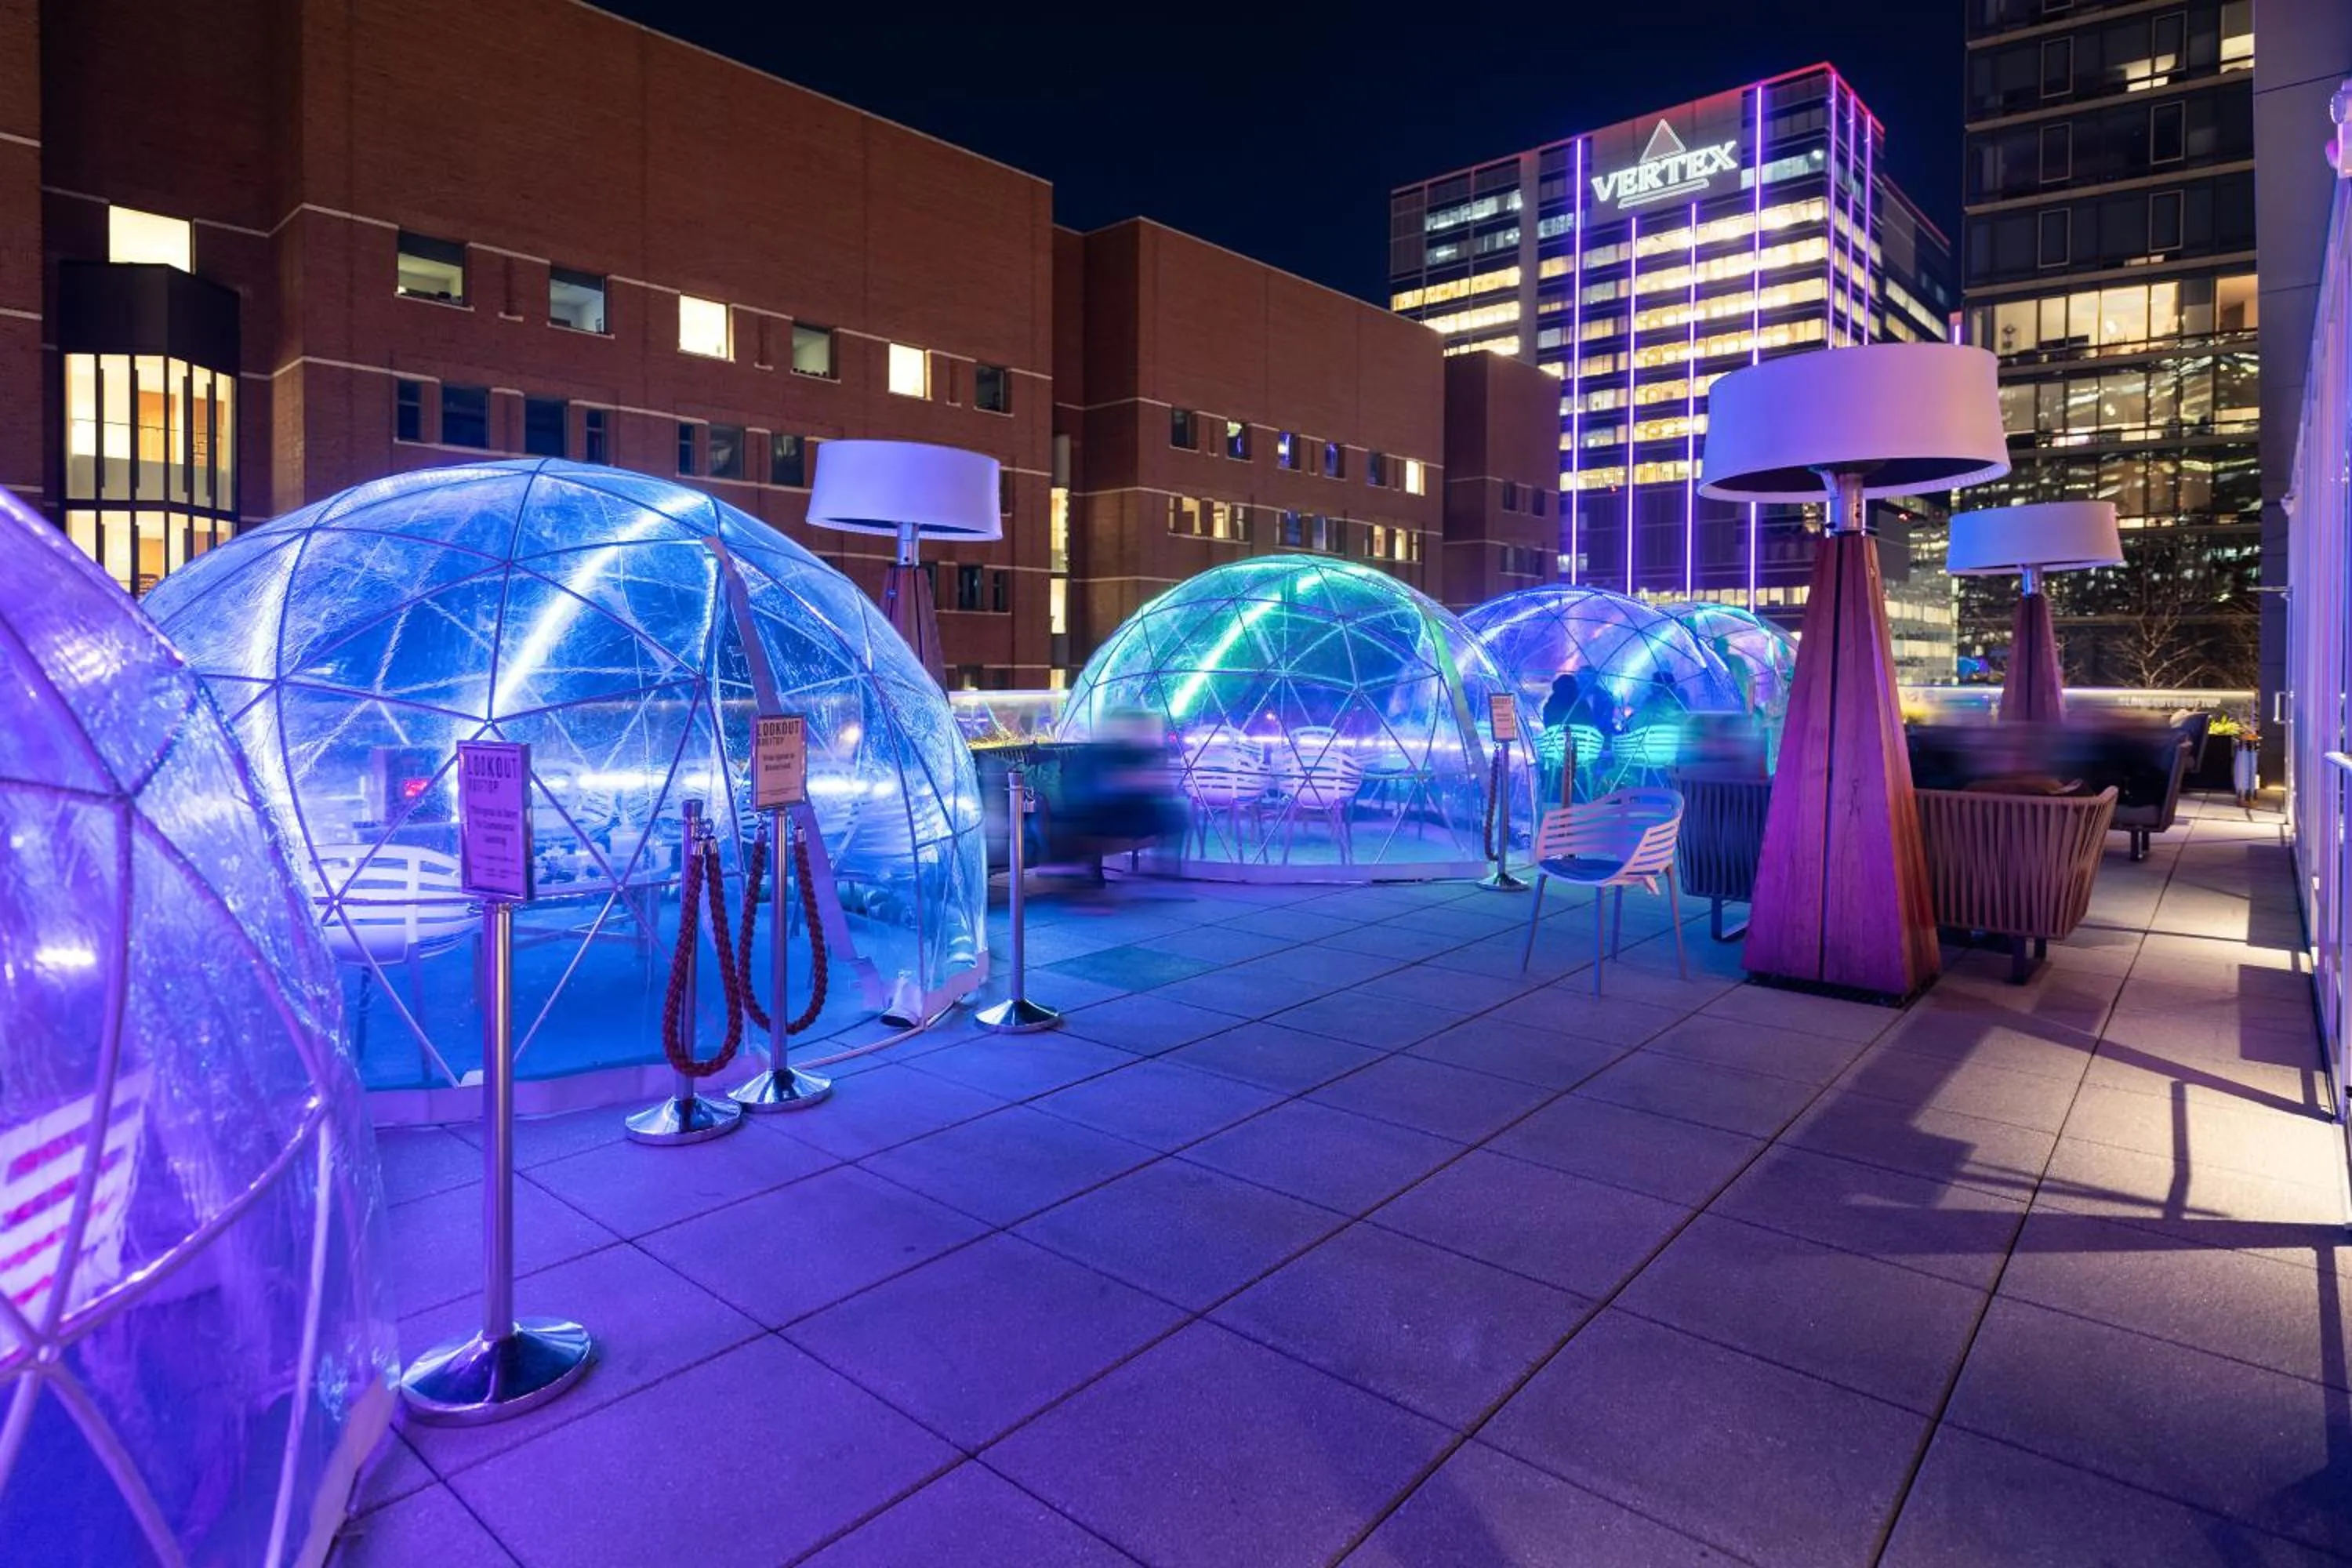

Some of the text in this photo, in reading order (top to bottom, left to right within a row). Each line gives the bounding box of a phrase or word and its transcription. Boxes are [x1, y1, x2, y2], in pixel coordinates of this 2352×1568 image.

[1591, 140, 1738, 202] VERTEX
[757, 720, 800, 736] LOOKOUT
[466, 753, 518, 779] LOOKOUT
